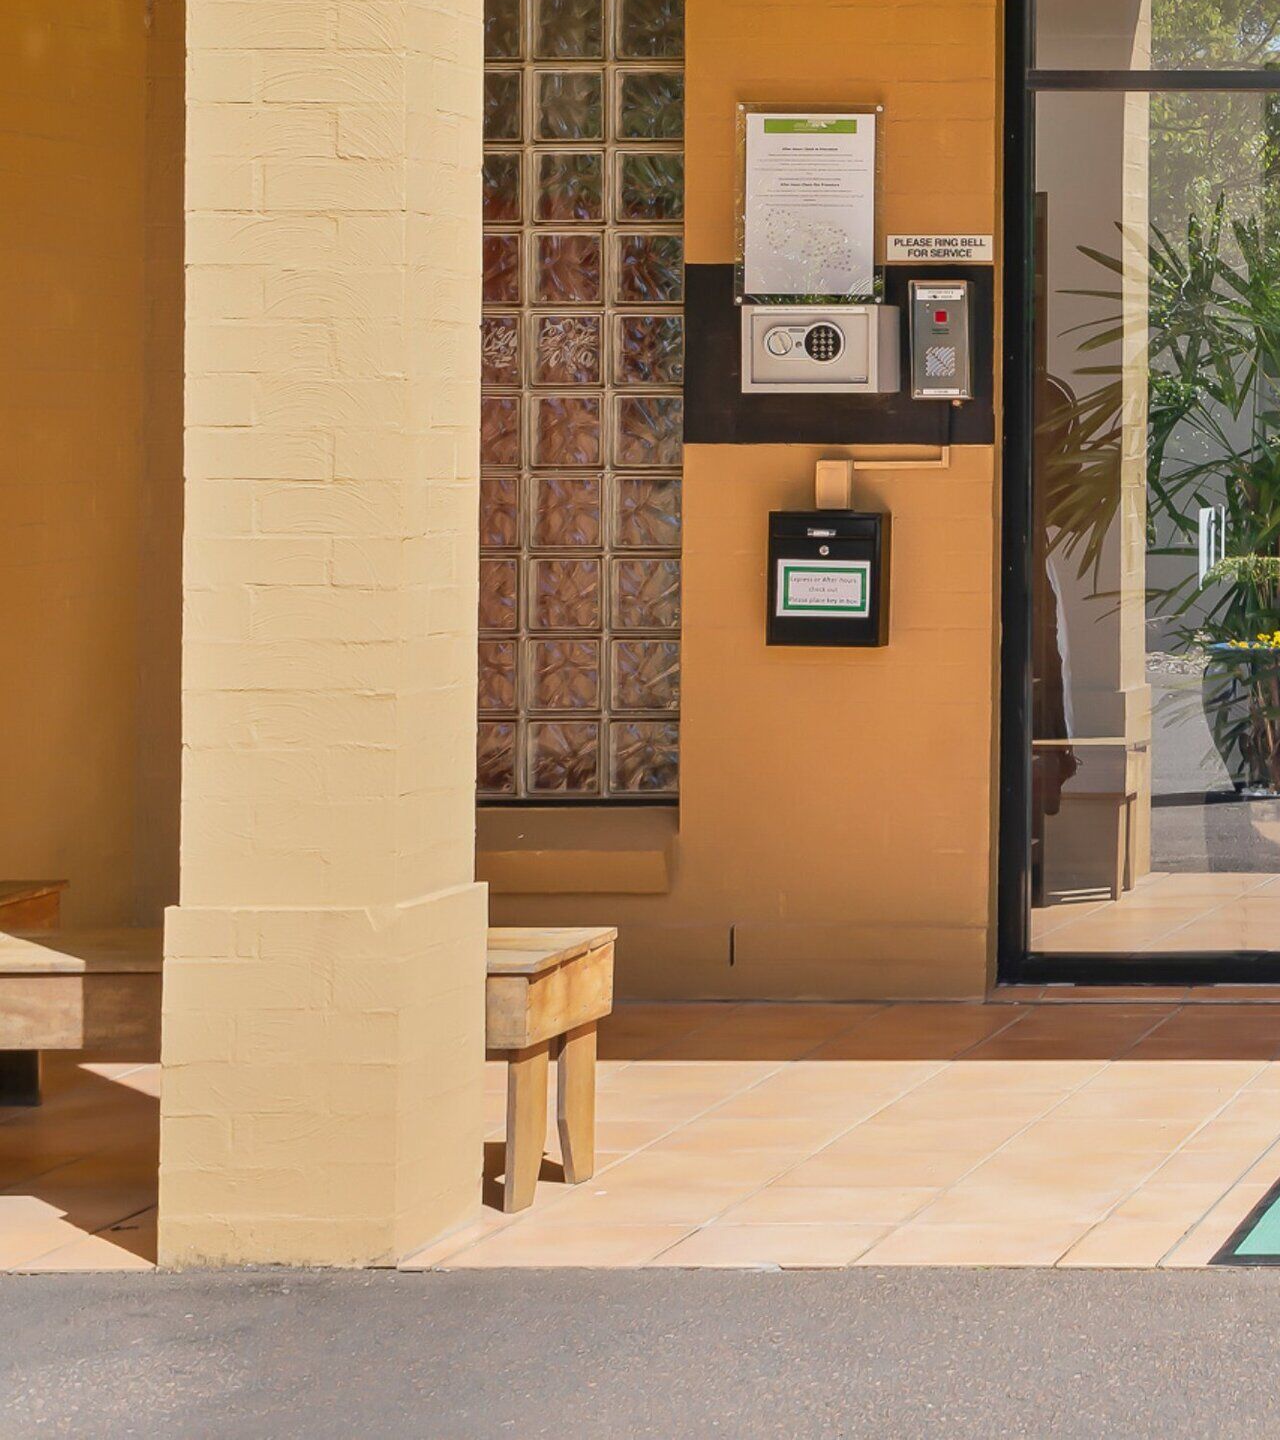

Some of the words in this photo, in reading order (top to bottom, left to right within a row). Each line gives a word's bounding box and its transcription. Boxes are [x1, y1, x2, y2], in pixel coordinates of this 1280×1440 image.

[894, 238, 933, 247] PLEASE
[934, 238, 958, 247] RING
[960, 238, 986, 247] BELL
[907, 248, 928, 258] FOR
[930, 248, 973, 258] SERVICE
